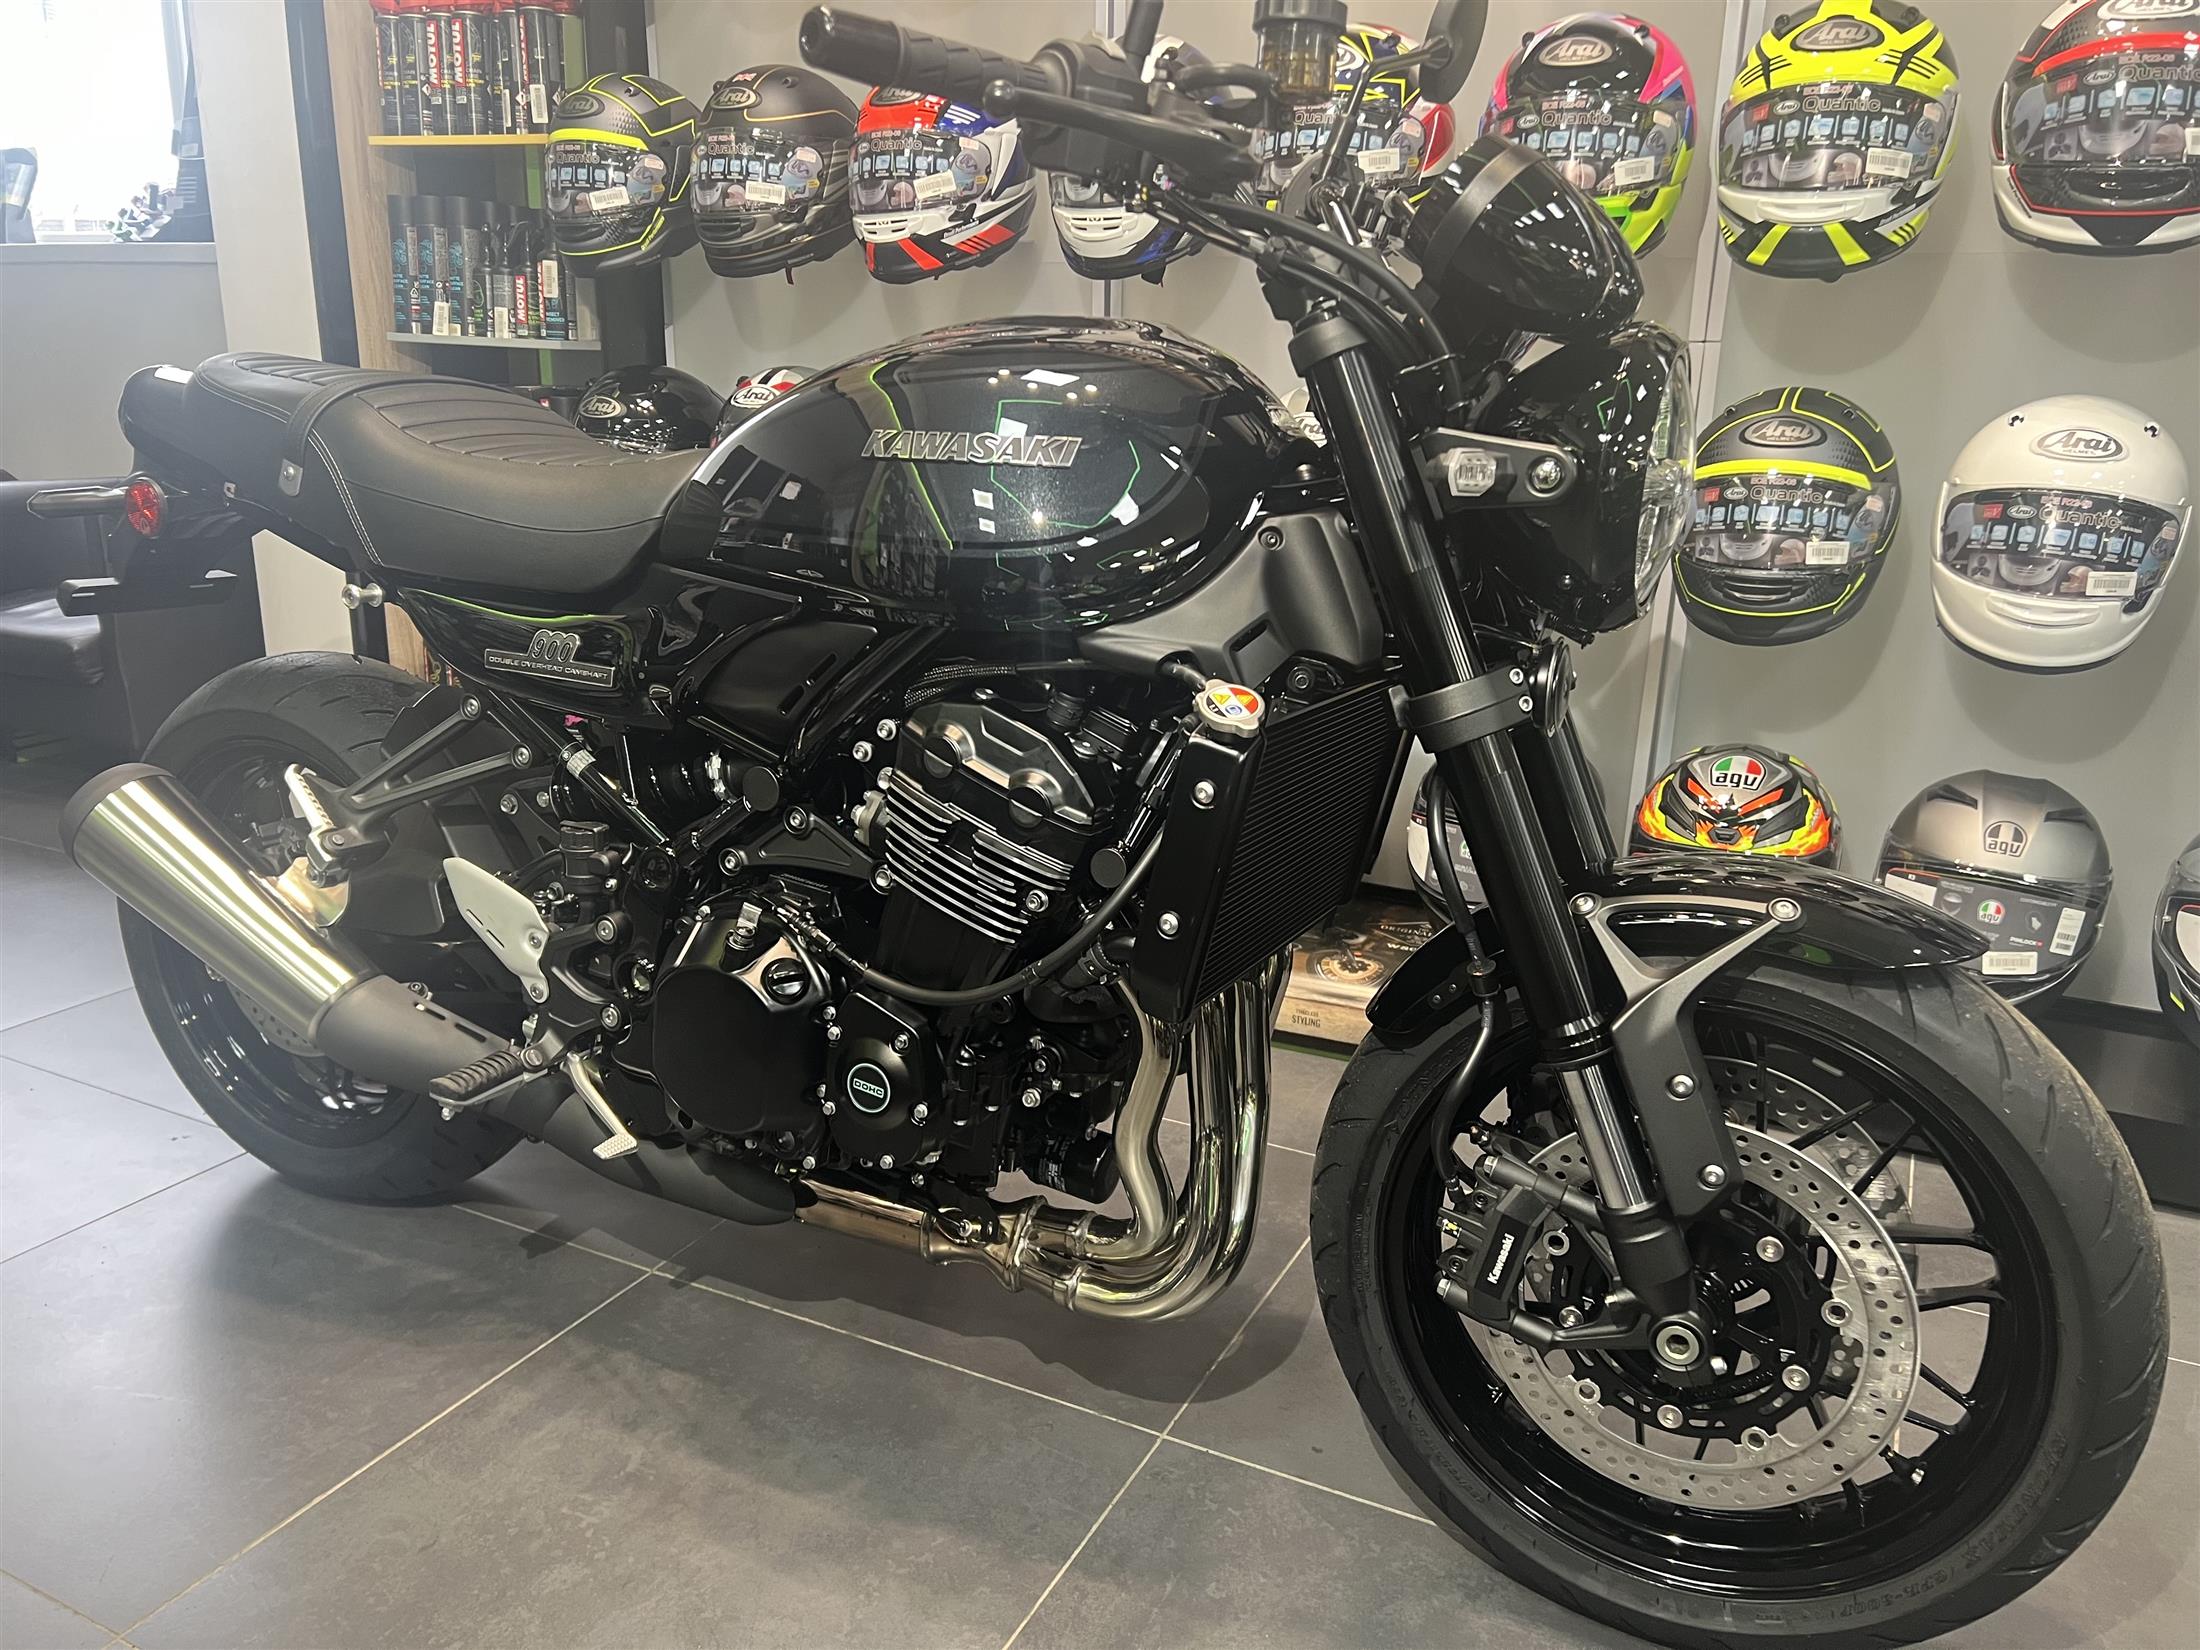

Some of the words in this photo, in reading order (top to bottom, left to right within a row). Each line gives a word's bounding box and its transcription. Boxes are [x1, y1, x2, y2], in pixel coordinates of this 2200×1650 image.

[1803, 23, 1869, 42] Arai
[426, 23, 439, 84] MOTUL
[452, 21, 463, 84] MOTUL
[1550, 40, 1603, 57] Arai
[2085, 72, 2114, 83] Arai
[1775, 102, 1798, 113] Arai
[1802, 95, 1881, 113] Quantic
[1294, 111, 1336, 125] Quan
[1542, 110, 1612, 127] Quantic
[708, 142, 755, 155] Quantic
[871, 137, 922, 152] Quantic
[556, 151, 600, 165] Quantic
[516, 279, 526, 321] MOTUL
[736, 389, 772, 400] Arai
[584, 396, 615, 413] Arai
[1752, 420, 1813, 438] Arai
[861, 429, 1083, 467] KAWASAKI
[2045, 432, 2113, 451] Arai
[1726, 488, 1747, 498] Arai
[1750, 485, 1823, 504] Quantic
[2009, 507, 2035, 517] Arai
[2039, 504, 2120, 529] Quantic
[532, 638, 573, 663] 900
[489, 656, 519, 666] DOUBLE
[521, 661, 563, 673] OVERHEAD
[564, 668, 609, 680] CAMSHAFT
[1716, 772, 1758, 788] agv
[1988, 839, 2021, 855] agv
[1980, 913, 2000, 923] agv
[1291, 1014, 1321, 1028] STYLING
[854, 1080, 883, 1096] DOHC
[1487, 1233, 1516, 1285] Kawasaki
